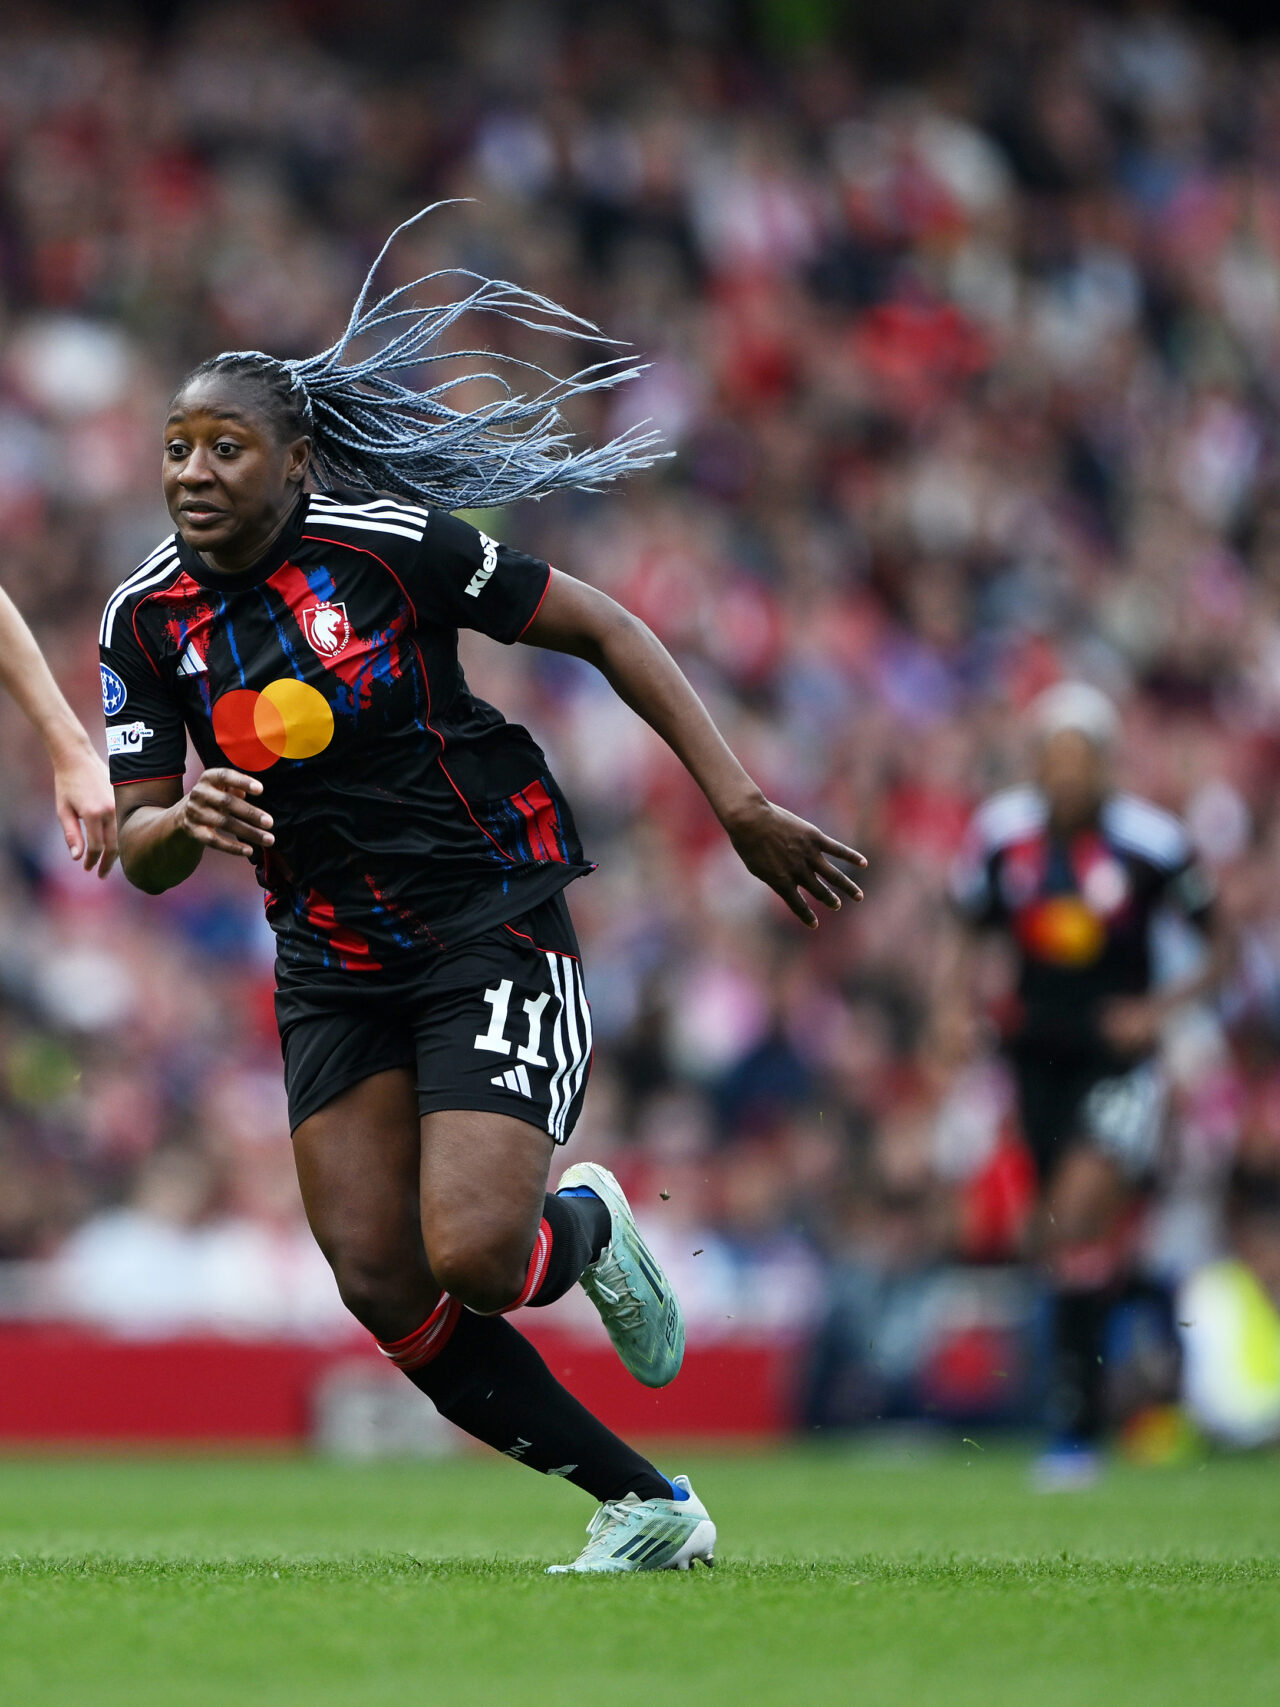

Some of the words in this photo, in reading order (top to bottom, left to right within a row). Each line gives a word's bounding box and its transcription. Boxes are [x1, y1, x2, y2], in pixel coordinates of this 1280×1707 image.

[339, 621, 351, 650] LYONNES
[121, 730, 140, 745] 10
[474, 978, 551, 1068] 11
